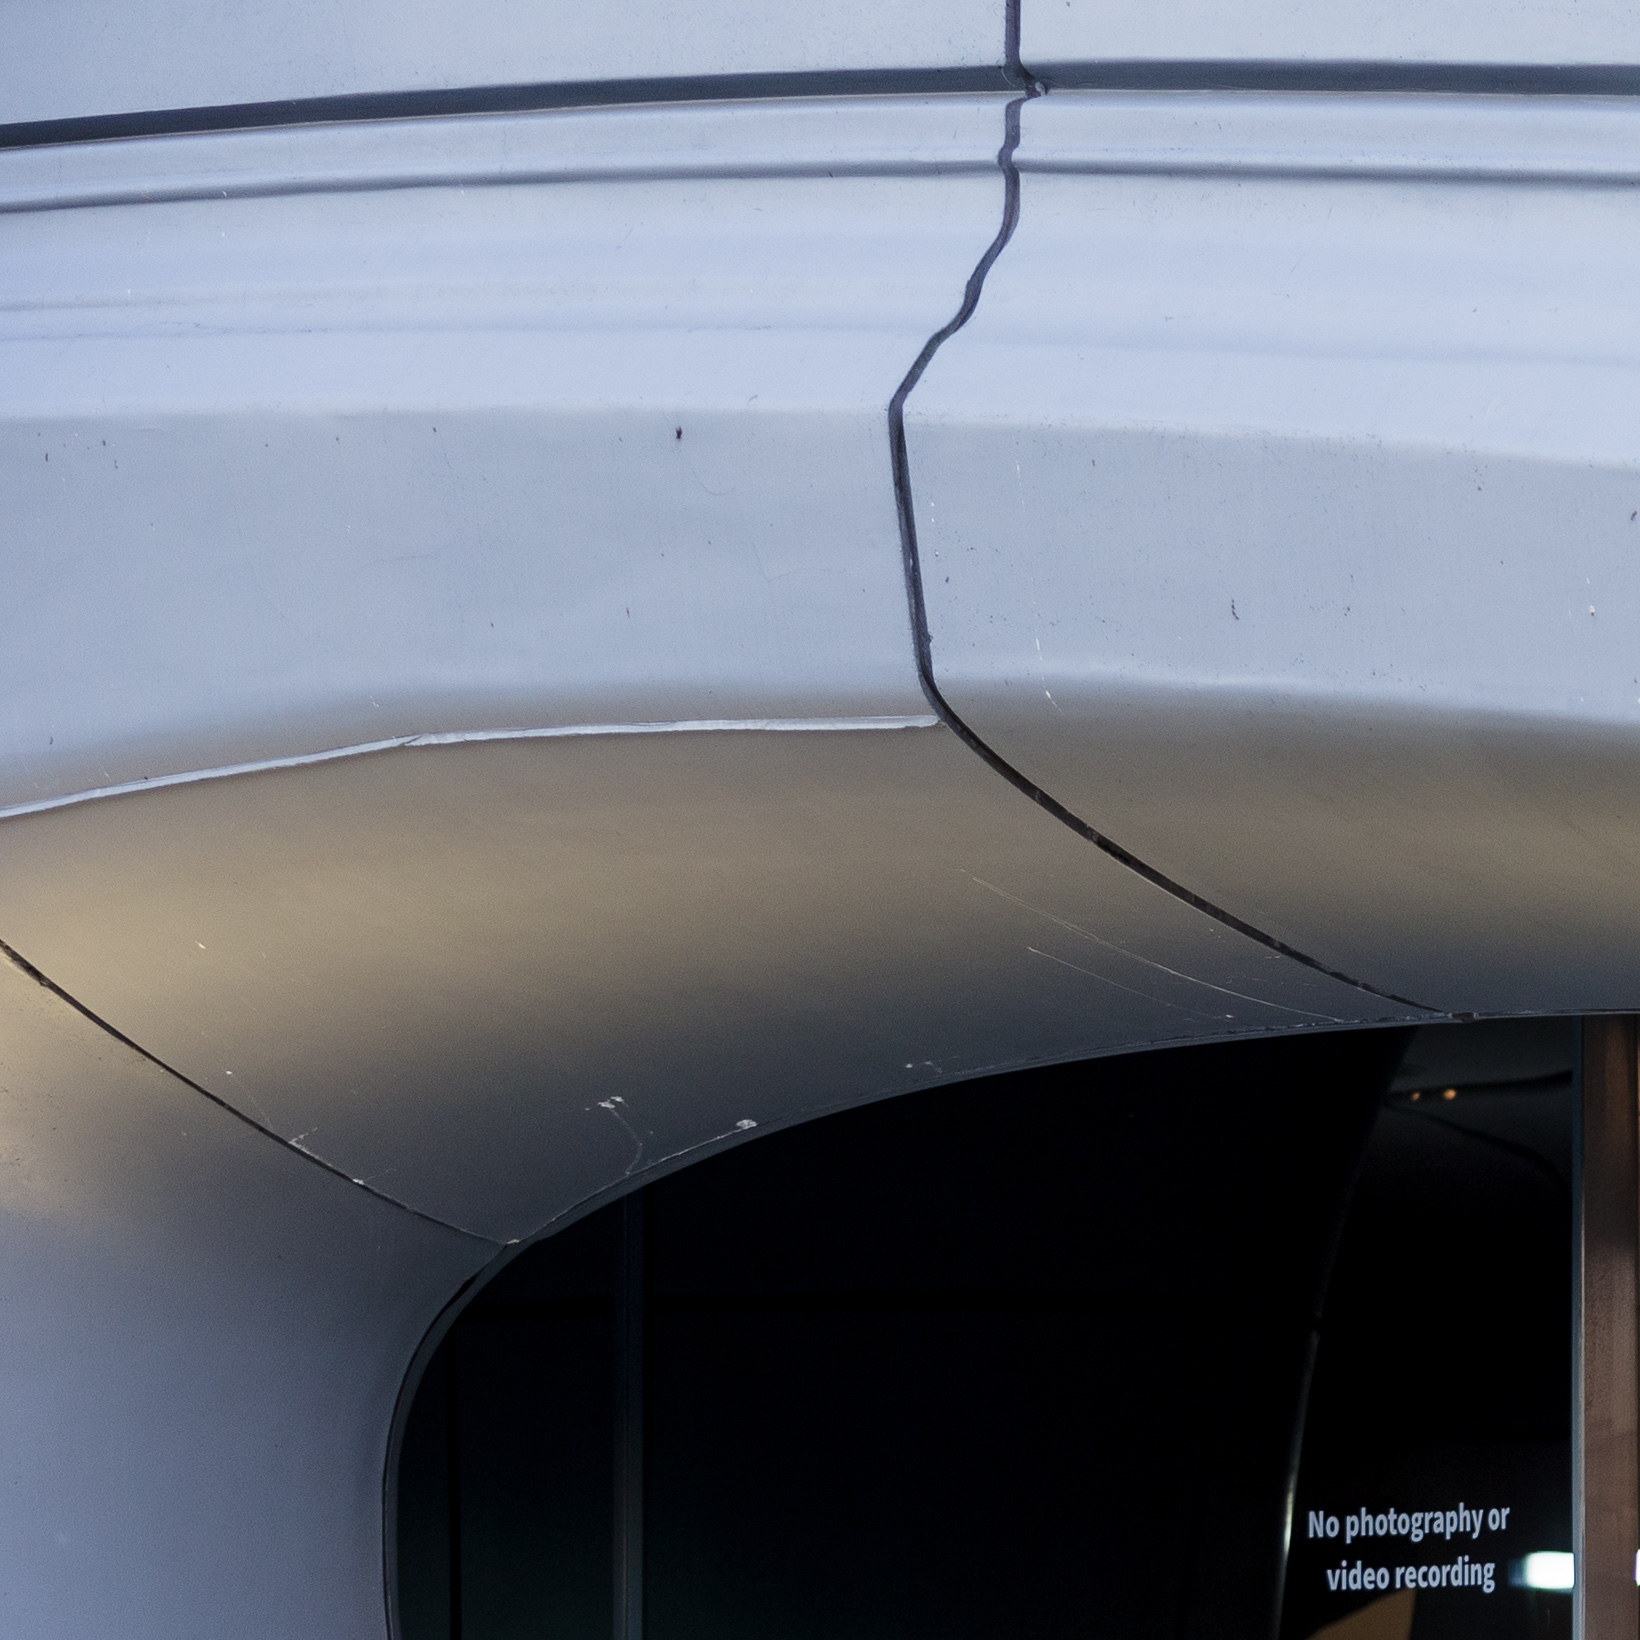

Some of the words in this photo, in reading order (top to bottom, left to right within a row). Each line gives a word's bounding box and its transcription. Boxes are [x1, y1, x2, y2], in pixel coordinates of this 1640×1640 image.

[1308, 1510, 1340, 1538] No
[1346, 1503, 1483, 1544] photography
[1487, 1507, 1511, 1531] or
[1326, 1560, 1390, 1591] video
[1395, 1555, 1496, 1593] recording
